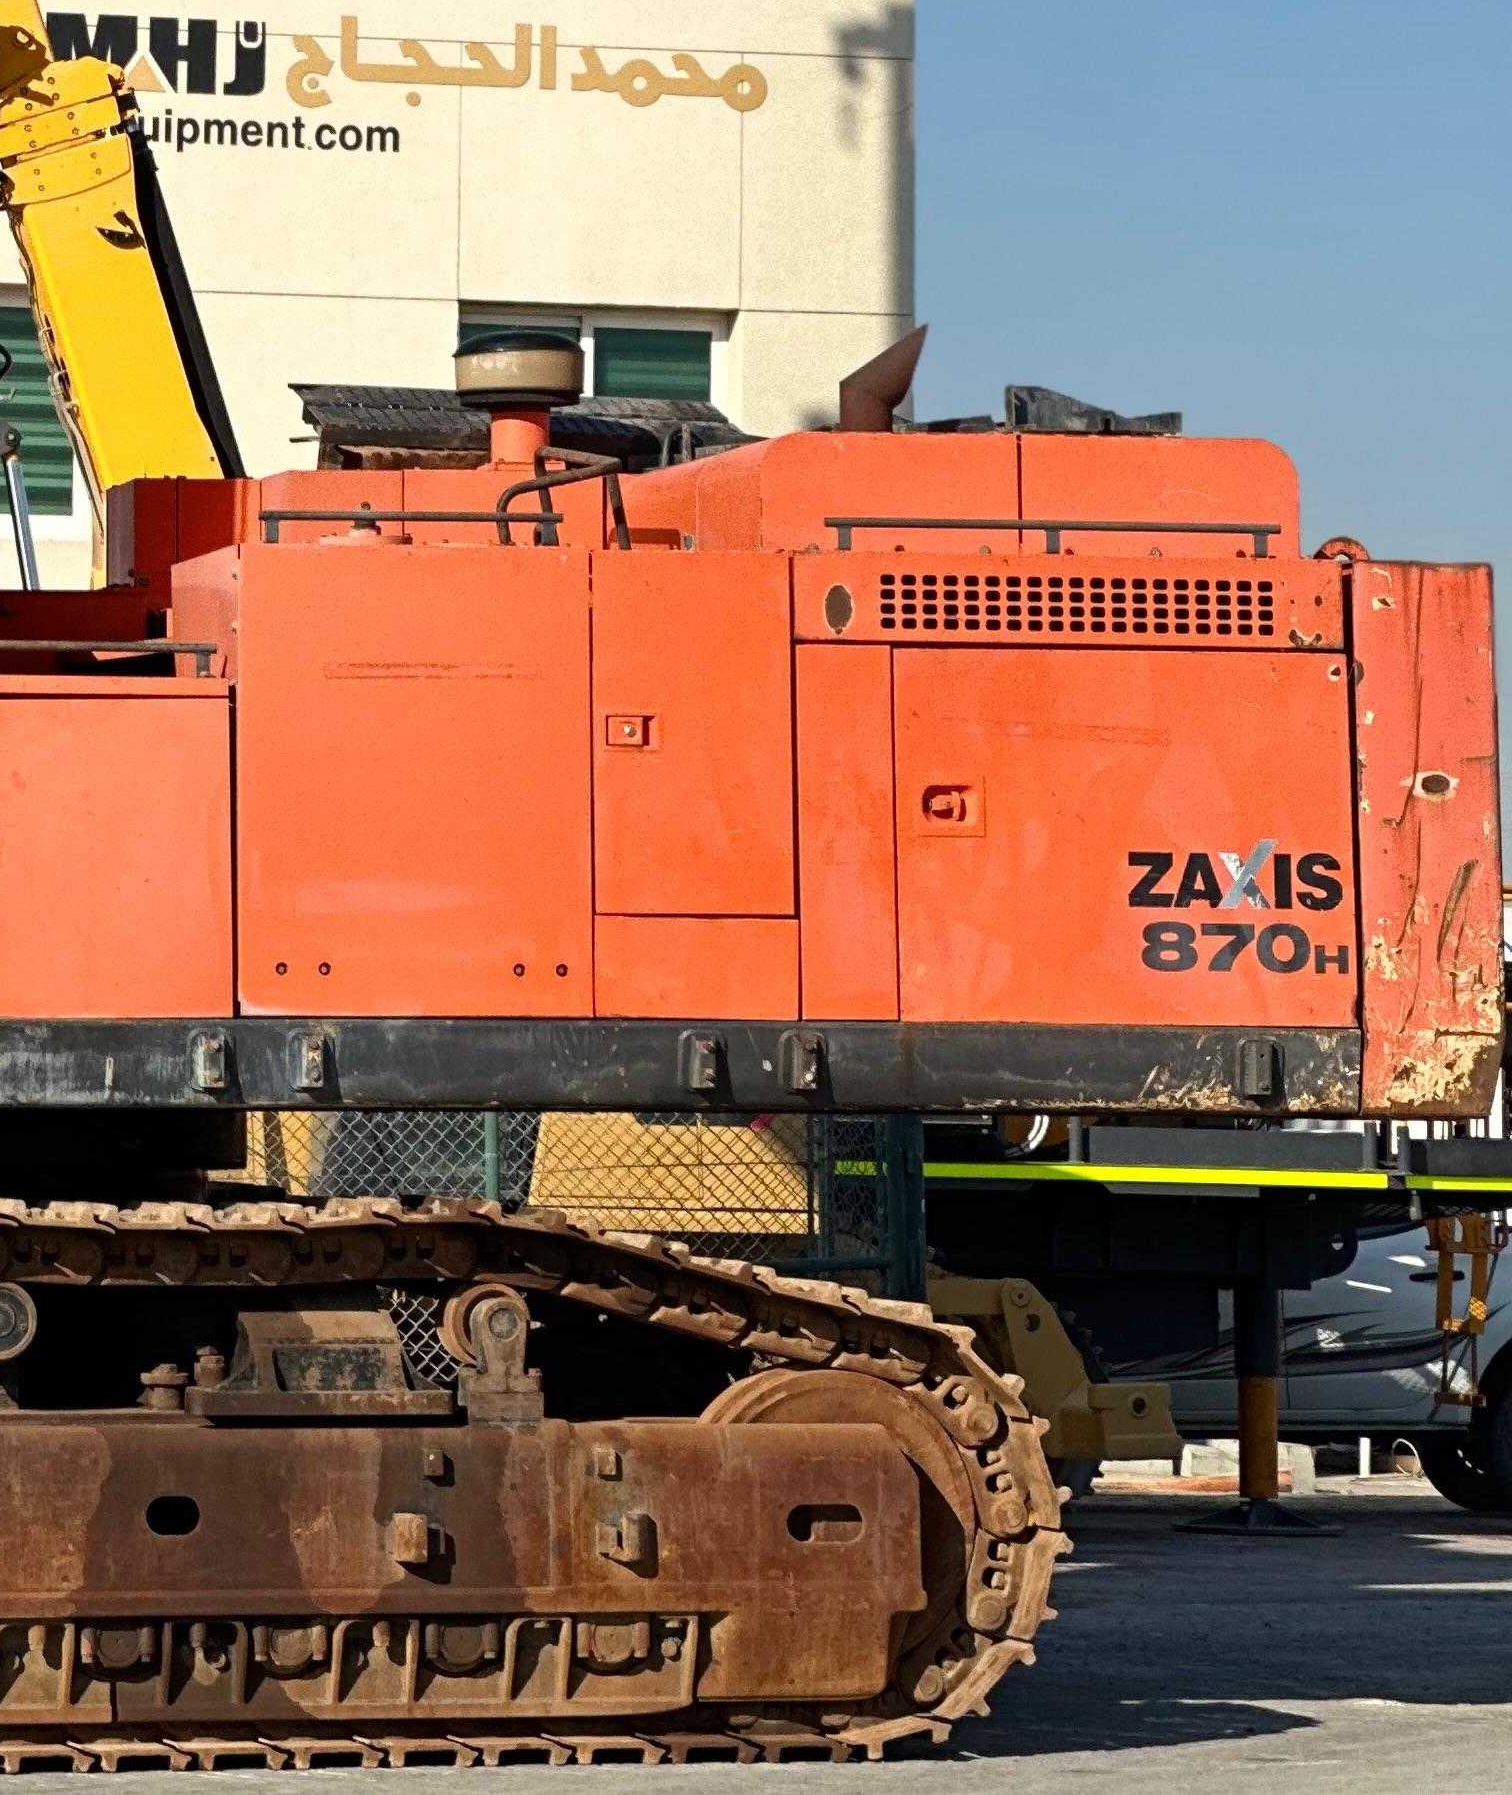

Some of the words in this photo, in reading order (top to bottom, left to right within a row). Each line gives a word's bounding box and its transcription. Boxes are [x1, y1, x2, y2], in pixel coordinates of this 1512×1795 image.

[285, 14, 557, 109] الحجاج
[570, 45, 768, 112] محمد
[138, 108, 401, 153] uipment.com
[1128, 838, 1343, 911] ZAXIS
